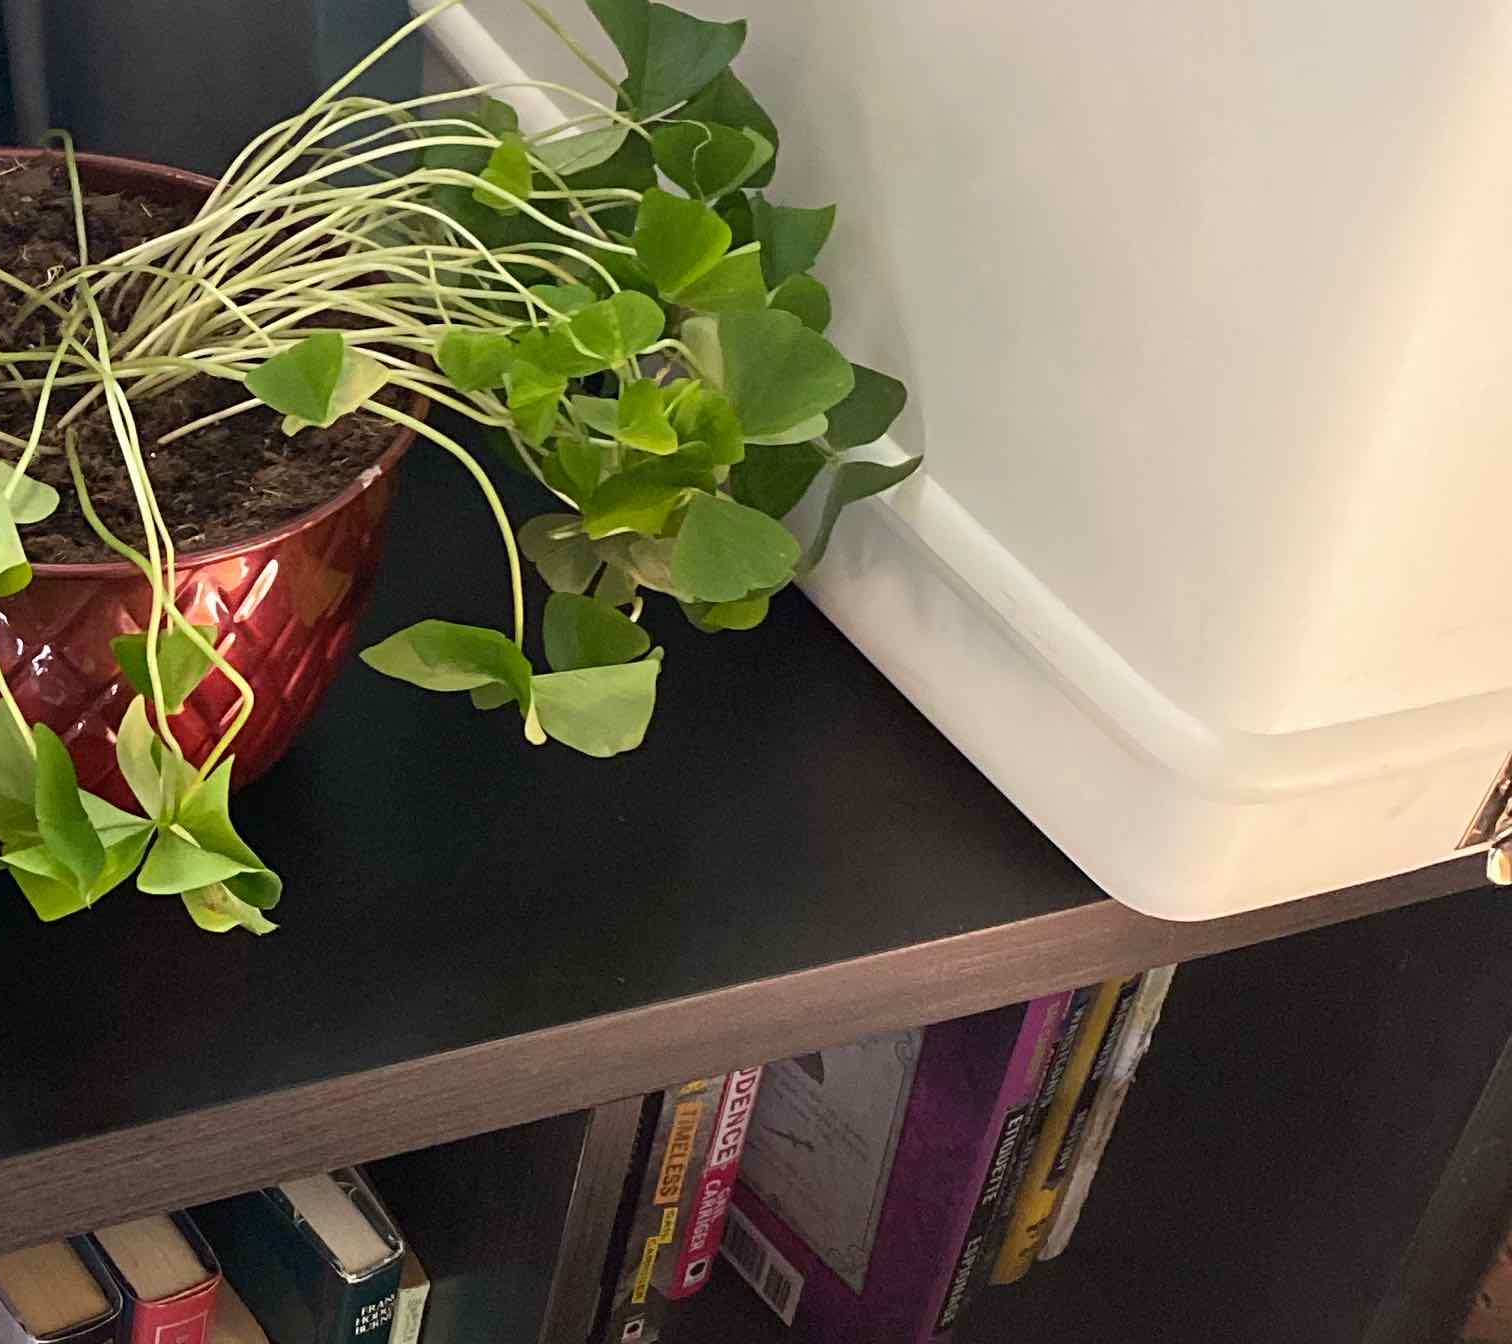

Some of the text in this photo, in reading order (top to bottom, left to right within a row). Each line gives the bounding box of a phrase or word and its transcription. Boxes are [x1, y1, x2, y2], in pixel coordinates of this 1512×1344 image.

[659, 1103, 698, 1199] TIMELESS
[715, 1064, 765, 1162] UDENCE
[982, 1114, 1025, 1206] ETIQUETTE
